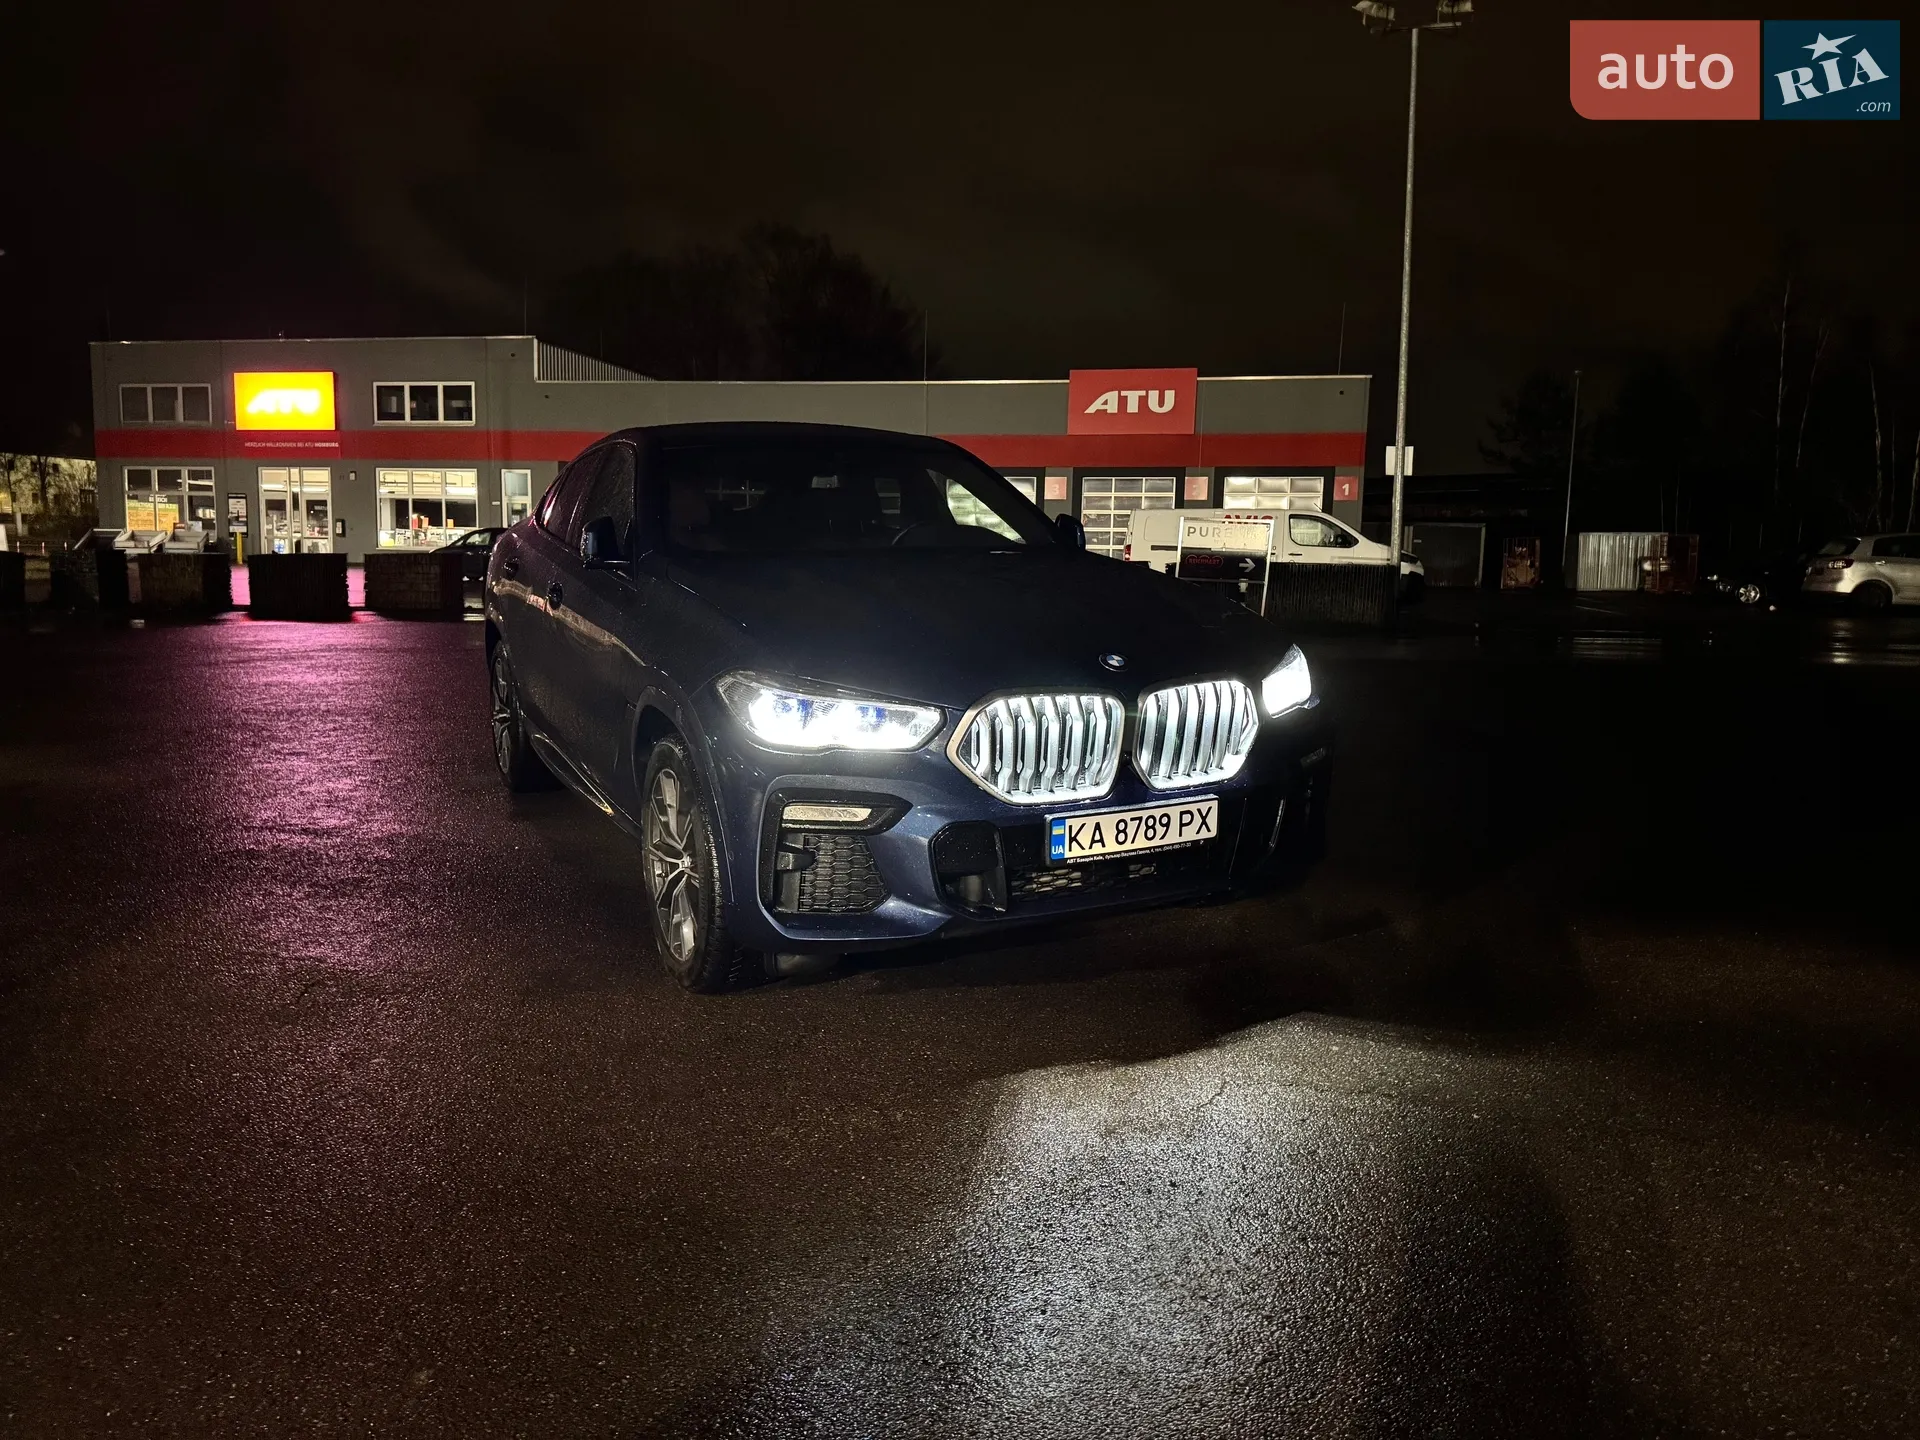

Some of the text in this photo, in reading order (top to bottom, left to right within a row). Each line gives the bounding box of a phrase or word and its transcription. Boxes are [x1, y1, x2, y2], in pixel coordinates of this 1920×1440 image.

[246, 389, 321, 415] ATU
[1084, 389, 1176, 414] ATU
[1051, 484, 1059, 496] 3
[1342, 483, 1349, 496] 1
[1068, 806, 1212, 852] KA 8789 PX
[1052, 845, 1064, 855] UA
